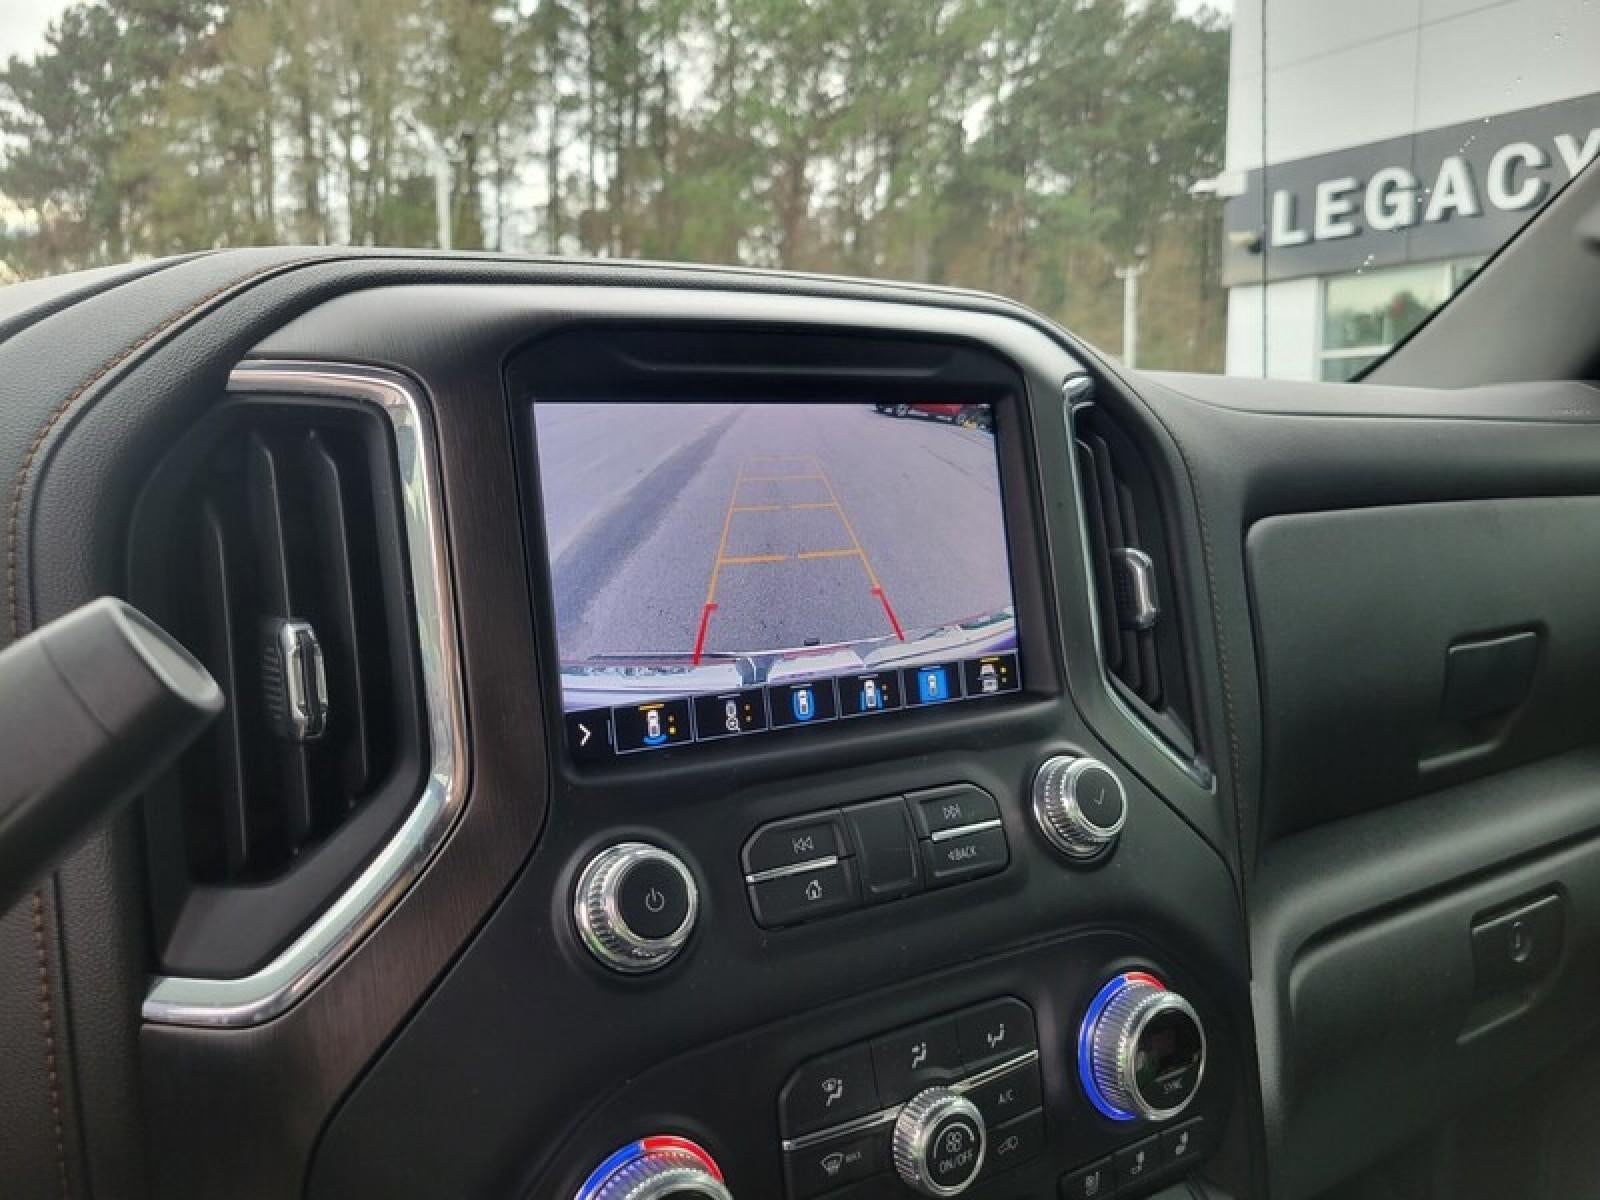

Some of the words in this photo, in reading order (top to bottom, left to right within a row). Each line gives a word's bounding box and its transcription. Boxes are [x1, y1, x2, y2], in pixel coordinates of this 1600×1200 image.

[1271, 127, 1600, 247] LEGACY
[997, 1088, 1015, 1105] A/C
[939, 1149, 973, 1174] ON/OFF
